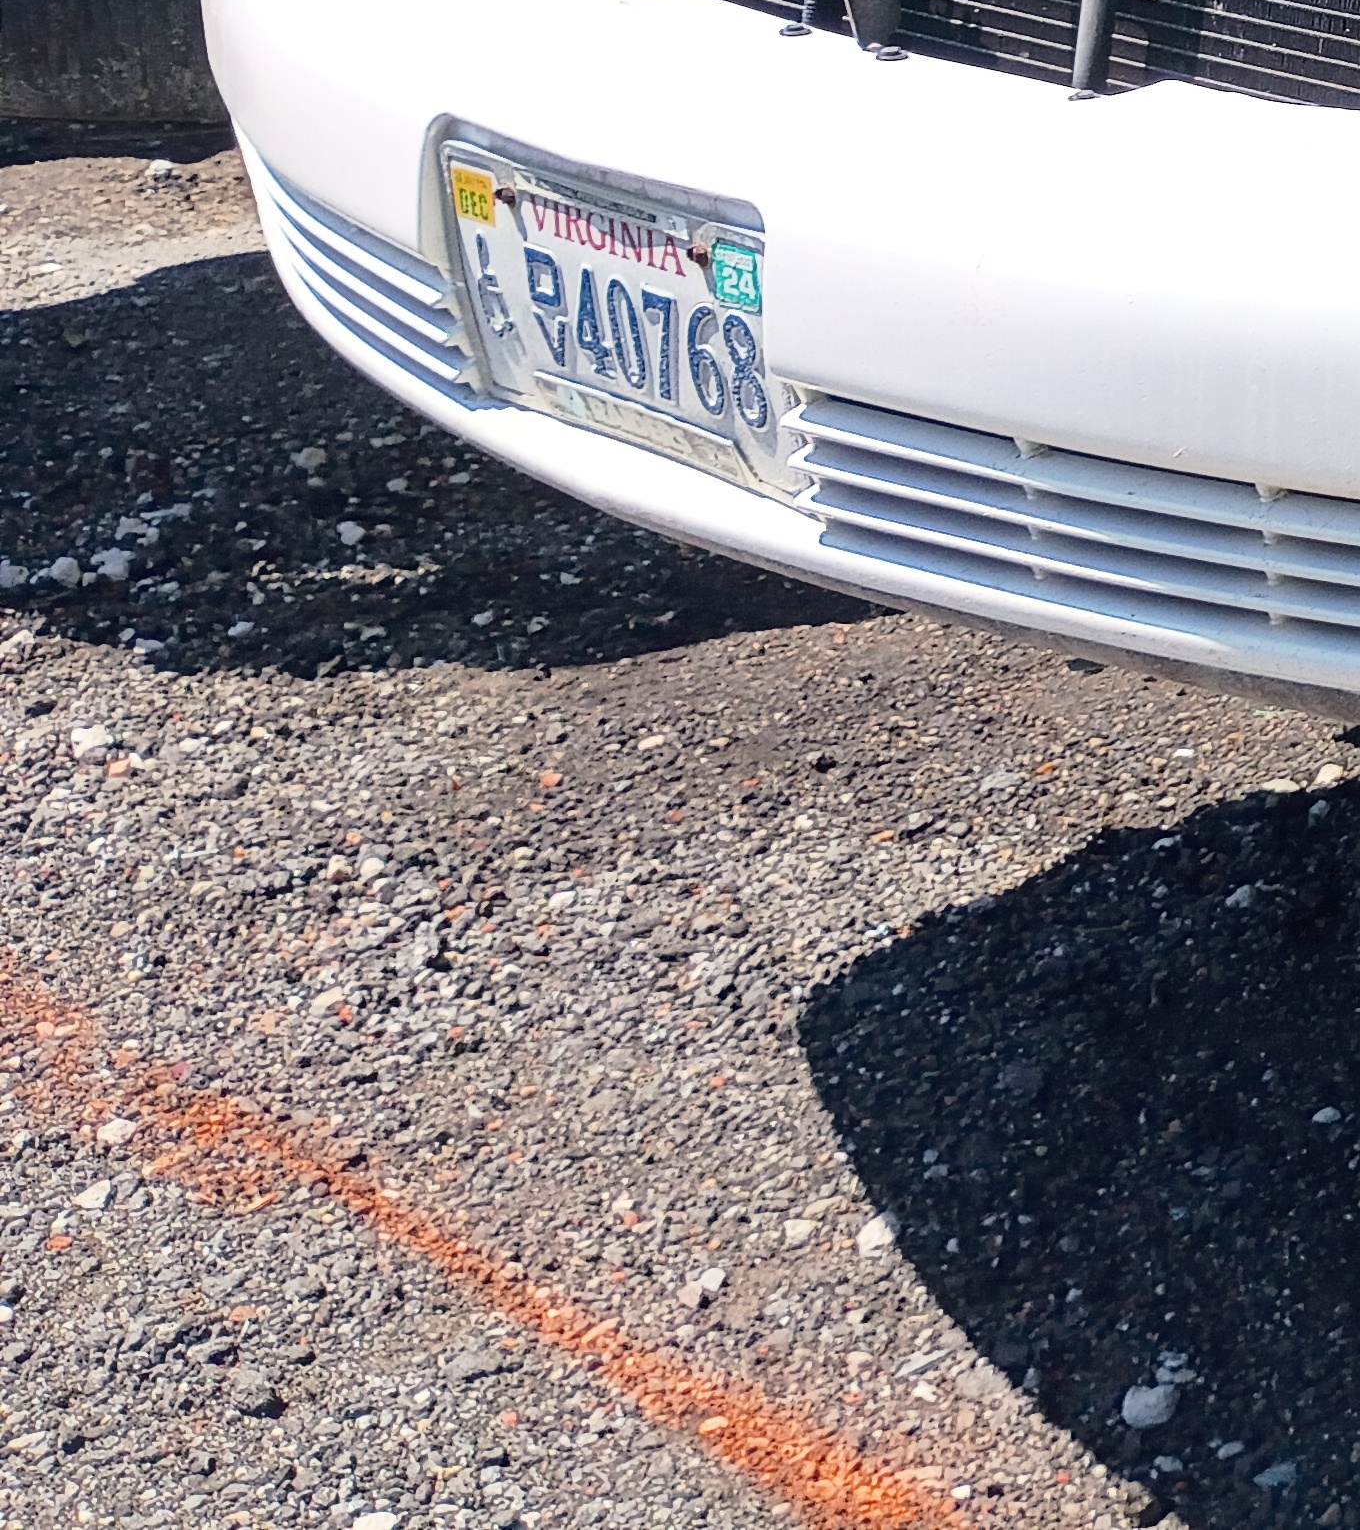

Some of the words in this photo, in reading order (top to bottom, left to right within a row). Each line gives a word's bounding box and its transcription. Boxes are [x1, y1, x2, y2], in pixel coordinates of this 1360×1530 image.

[459, 188, 489, 220] DEC
[529, 193, 687, 277] VIRGINIA
[722, 266, 756, 300] 24
